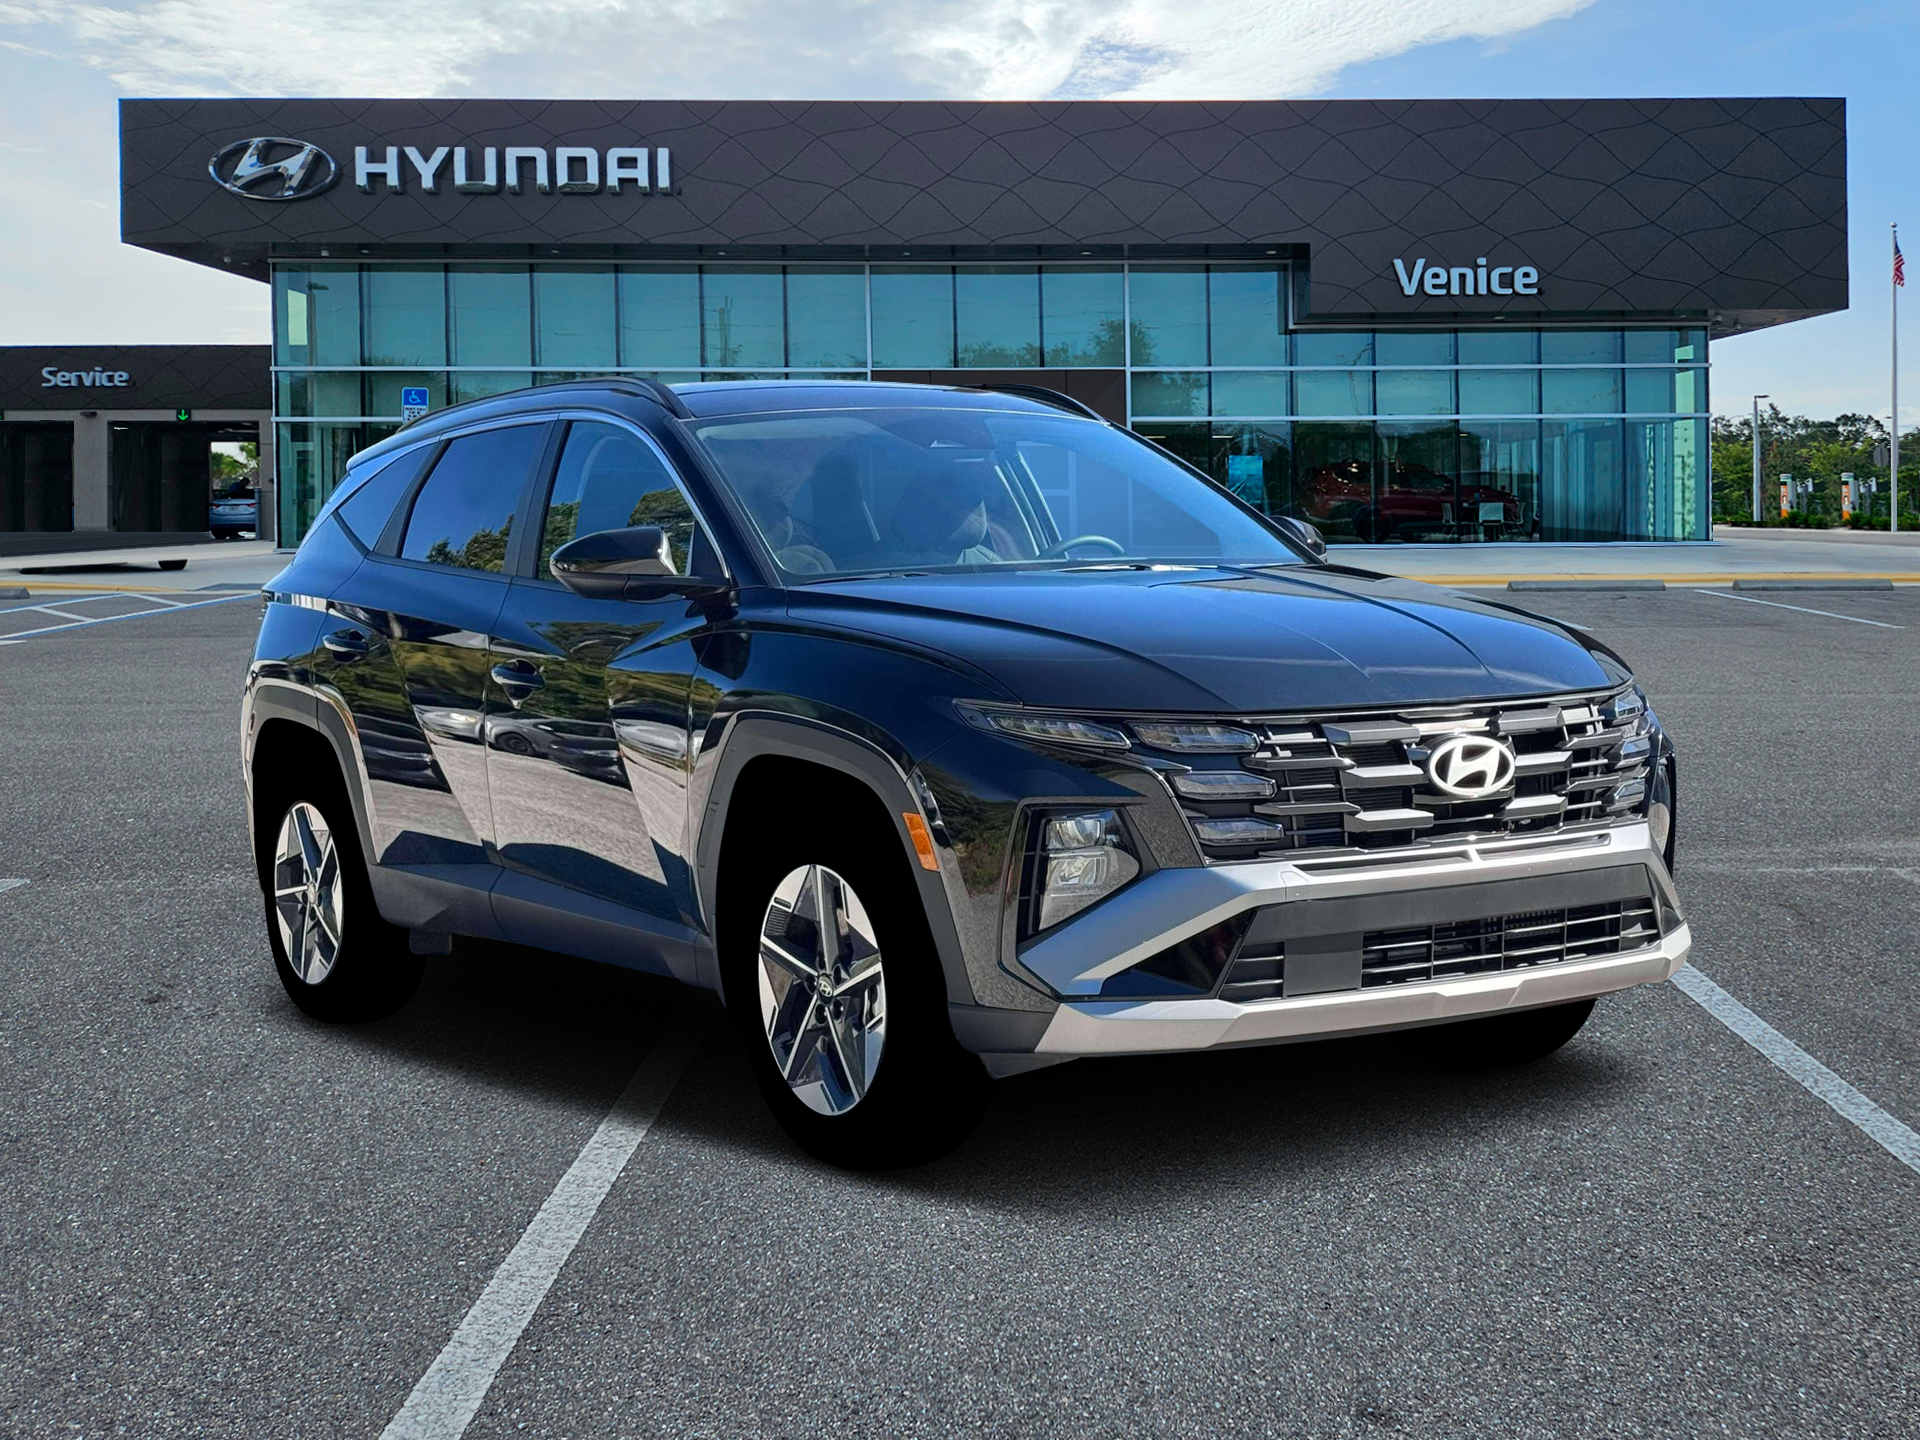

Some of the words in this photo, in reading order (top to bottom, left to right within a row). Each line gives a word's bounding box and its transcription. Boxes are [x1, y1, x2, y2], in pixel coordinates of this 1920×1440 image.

[354, 145, 673, 195] HYUNDAI
[1392, 256, 1540, 296] Venice
[41, 366, 131, 388] Service
